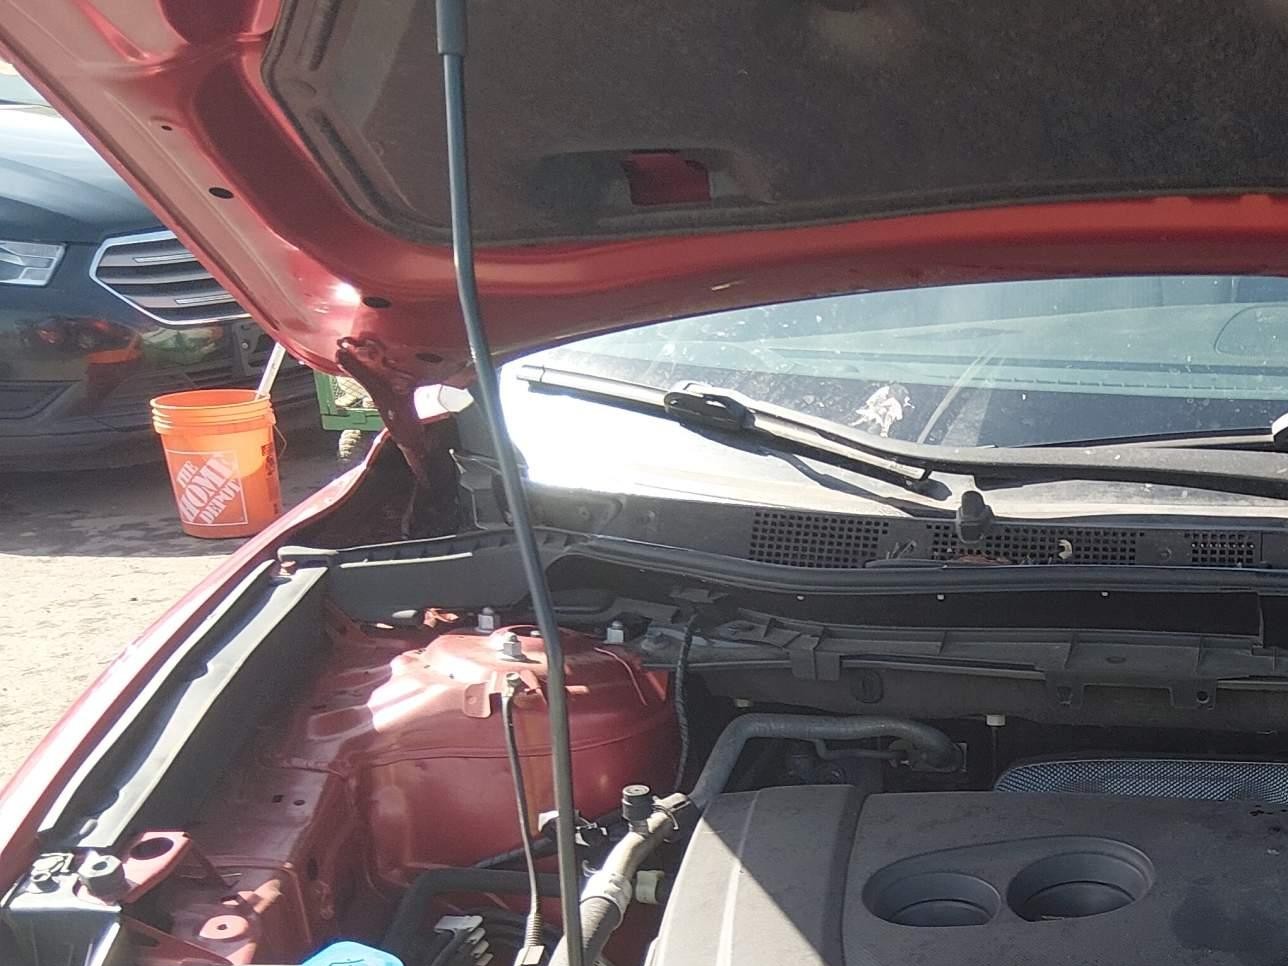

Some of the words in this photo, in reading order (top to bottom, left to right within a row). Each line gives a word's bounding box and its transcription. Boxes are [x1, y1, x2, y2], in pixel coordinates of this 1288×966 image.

[177, 460, 199, 488] THE
[180, 453, 236, 523] HOME
[199, 479, 240, 524] DEPOT
